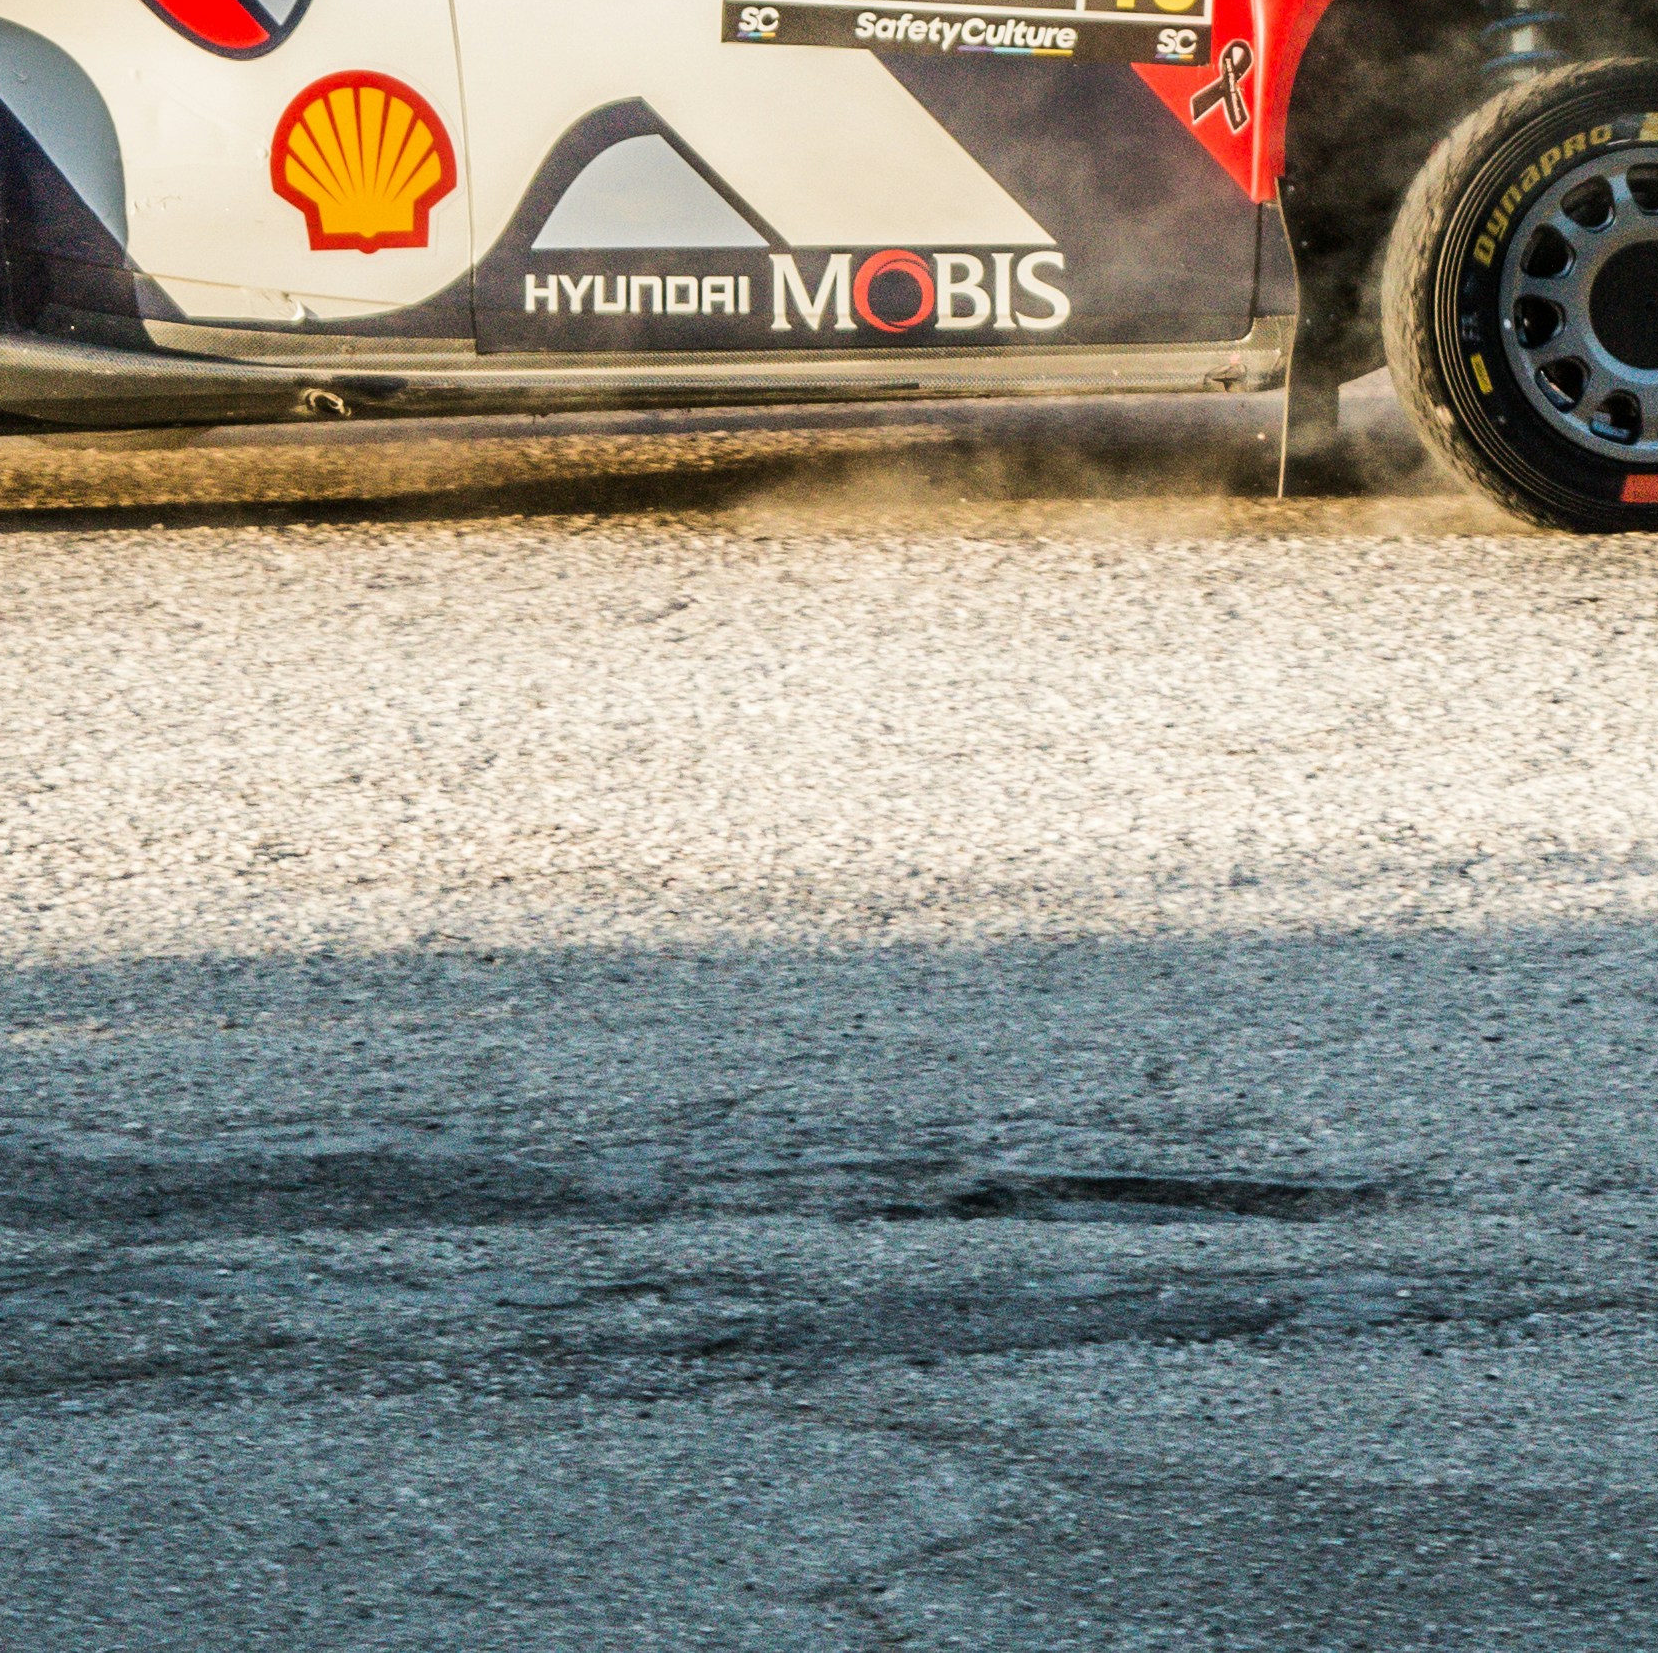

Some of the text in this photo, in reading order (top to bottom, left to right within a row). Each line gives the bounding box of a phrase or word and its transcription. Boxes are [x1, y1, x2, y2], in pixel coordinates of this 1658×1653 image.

[738, 6, 780, 33] SC
[854, 11, 1078, 51] SafetyCulture
[1156, 28, 1198, 55] SC
[525, 249, 1071, 332] HYUNDAI MOBIS
